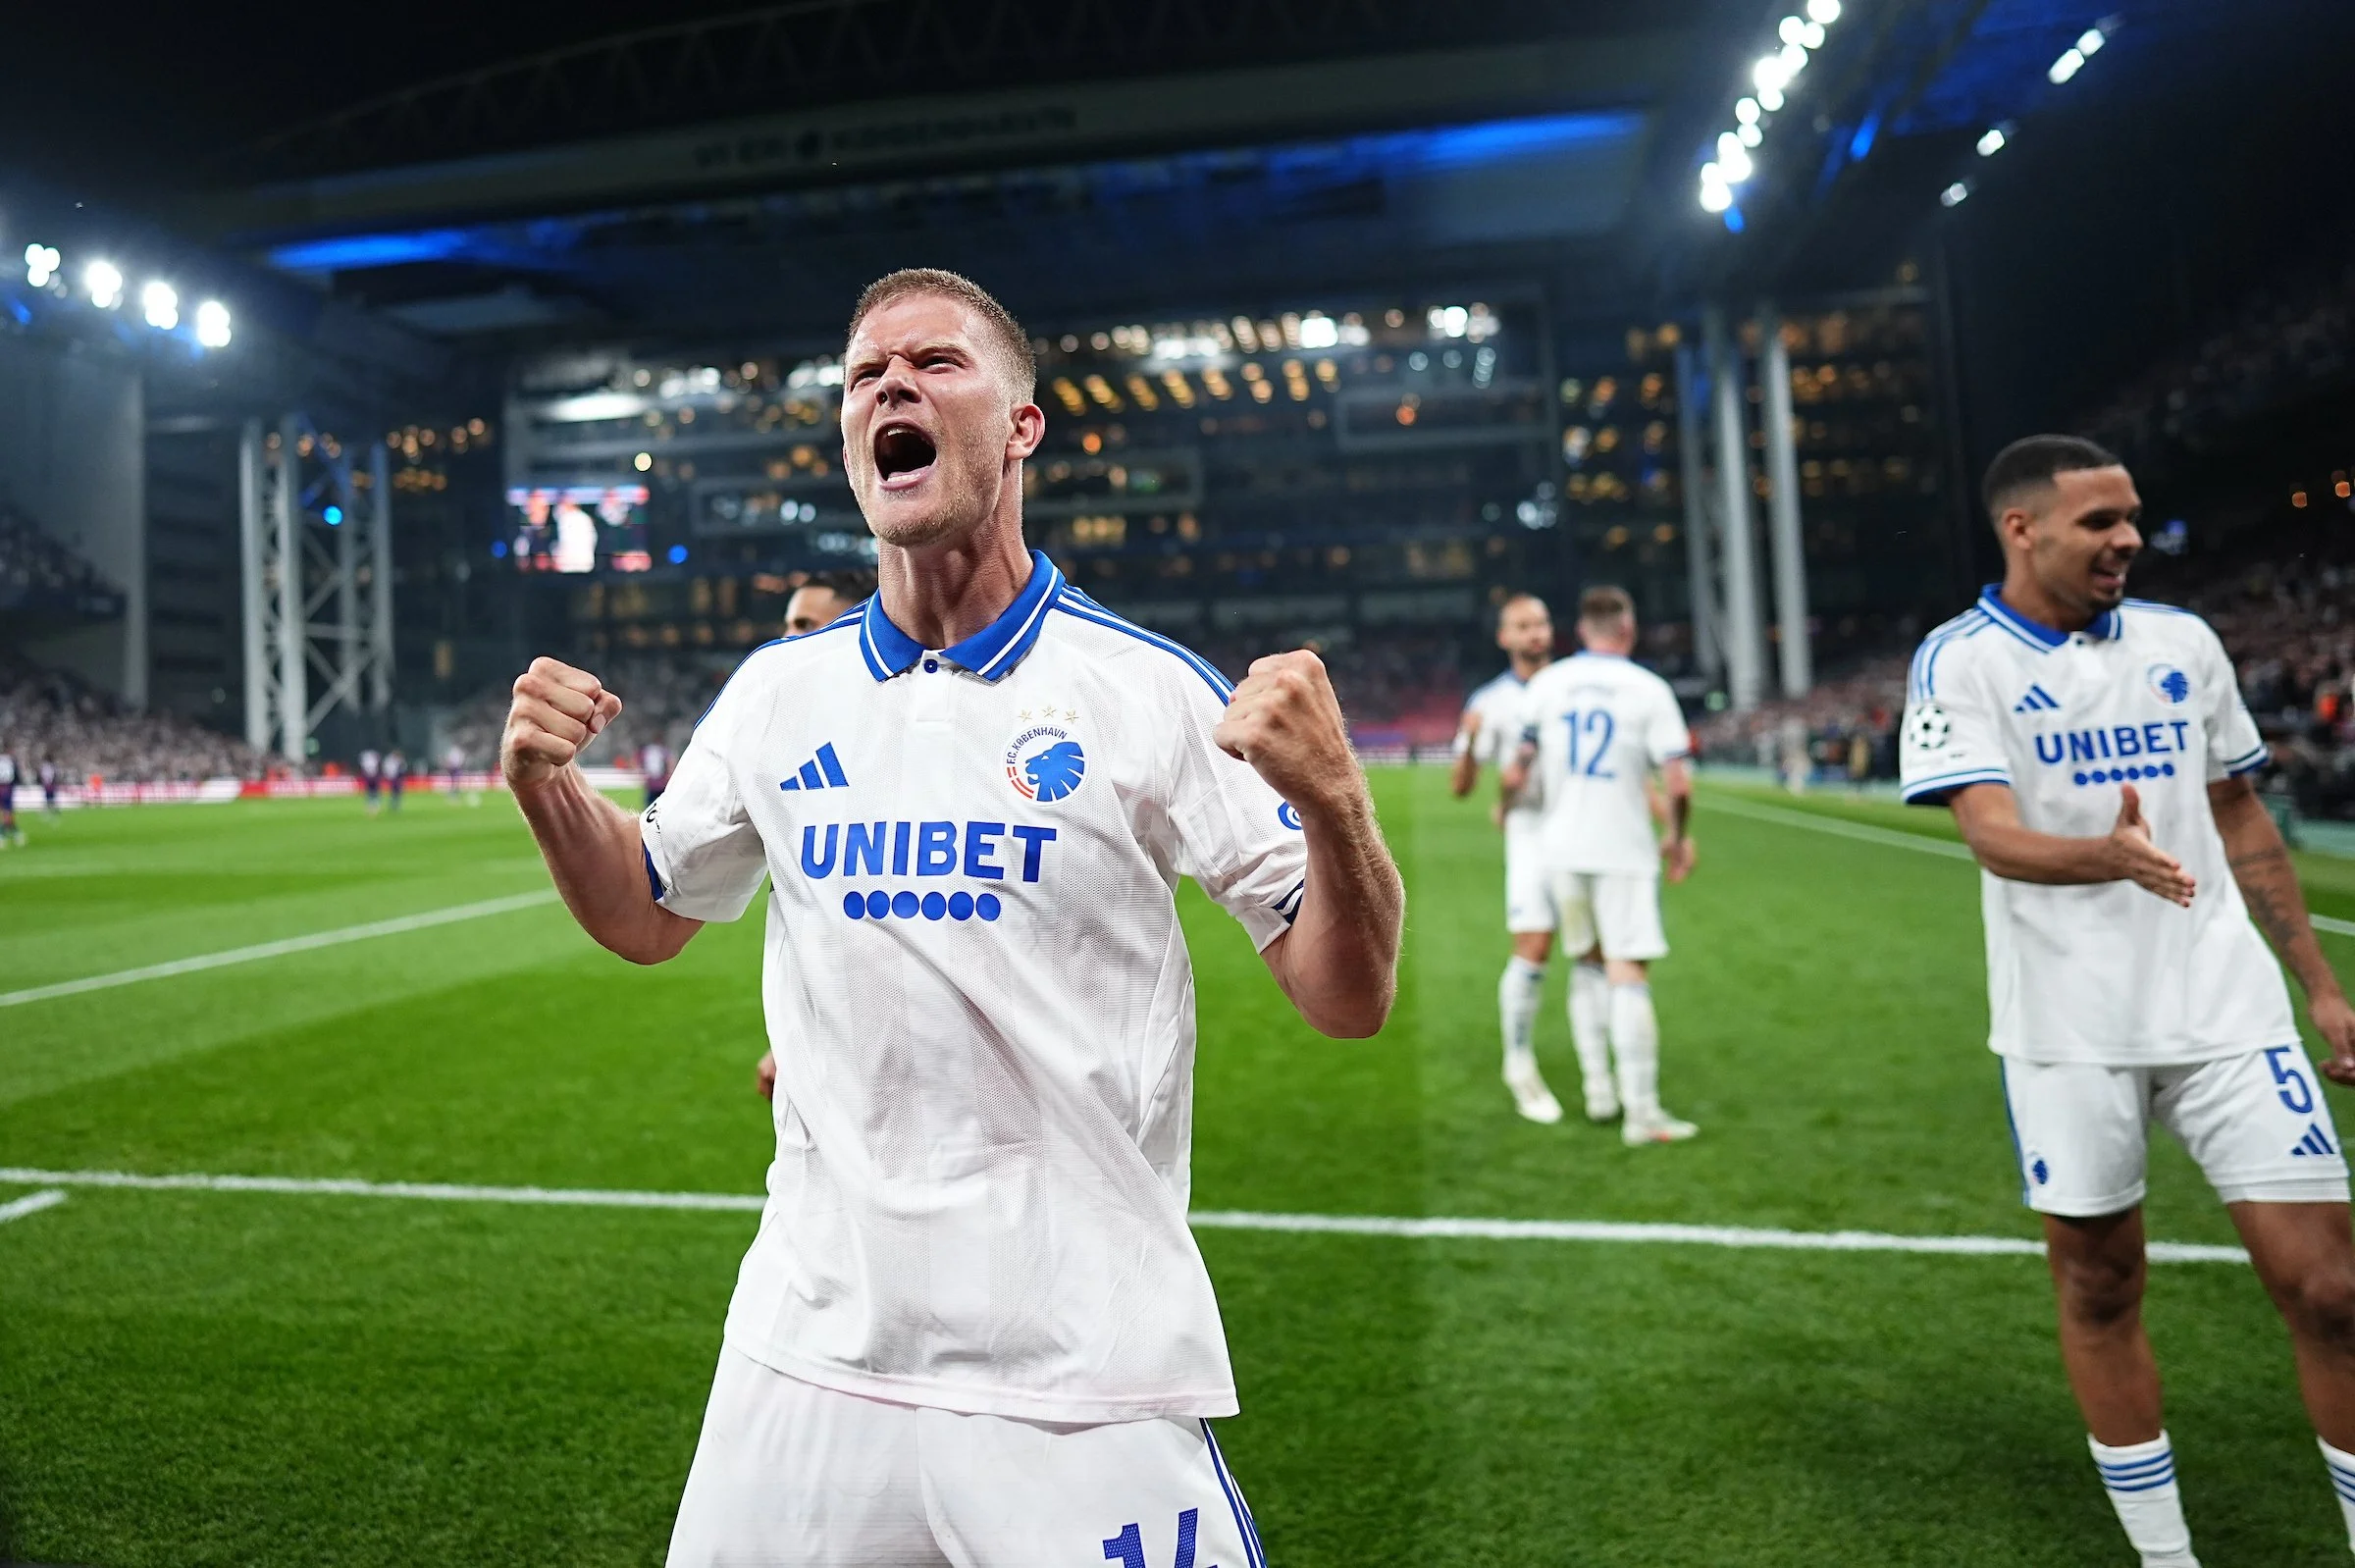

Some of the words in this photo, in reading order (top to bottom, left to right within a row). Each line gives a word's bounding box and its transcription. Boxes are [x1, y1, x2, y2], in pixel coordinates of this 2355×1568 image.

[1560, 707, 1616, 777] 12
[2036, 720, 2189, 763] UNIBET
[801, 821, 1057, 882] UNIBET
[2264, 1045, 2314, 1114] 5
